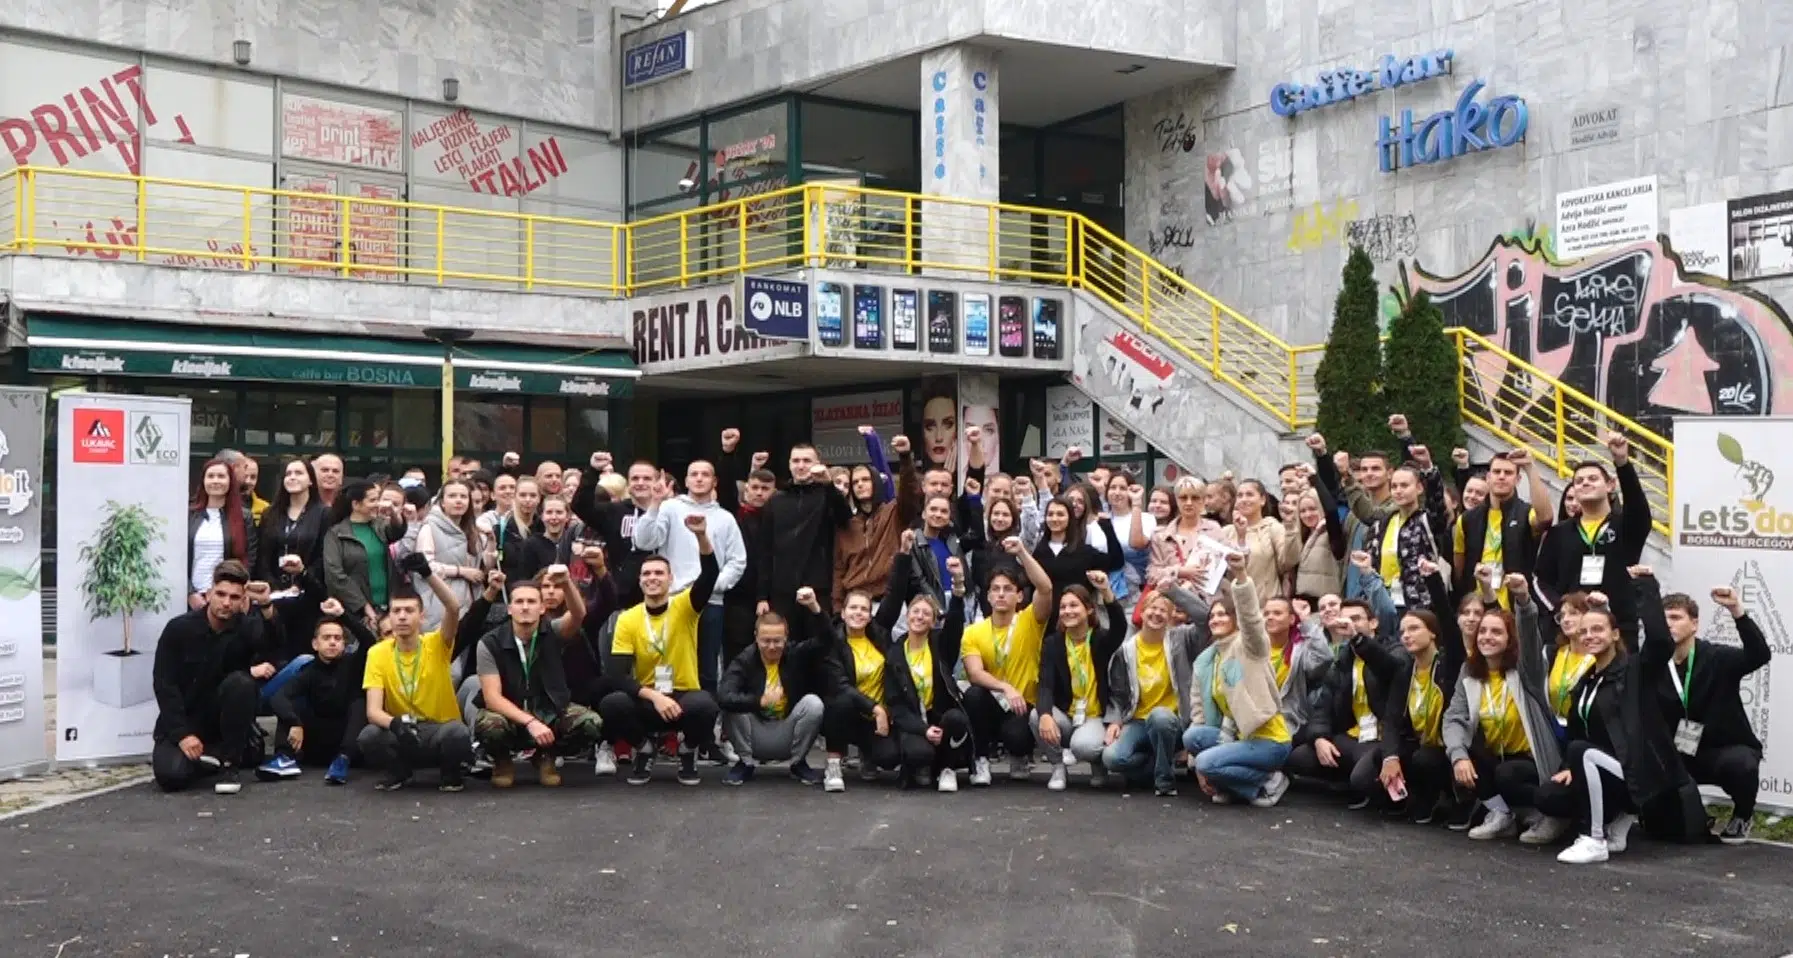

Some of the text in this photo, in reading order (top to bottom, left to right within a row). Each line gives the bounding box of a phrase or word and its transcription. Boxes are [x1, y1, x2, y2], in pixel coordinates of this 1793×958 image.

[1271, 48, 1454, 117] Caffe bar
[0, 64, 157, 173] PRINT
[410, 107, 473, 150] NALJEPNICE
[1377, 77, 1529, 173] Hako
[1571, 108, 1617, 128] ADVOKAT
[320, 125, 360, 146] print
[439, 122, 481, 151] VIZITKE
[469, 124, 512, 155] FLAJERI
[458, 149, 502, 180] PLAKATI
[1561, 183, 1653, 208] ADVOKATSKA KANCELARIJA
[751, 281, 802, 294] BANKOMAT
[774, 300, 803, 318] NLB
[633, 302, 689, 365] RENT
[694, 300, 711, 357] A
[346, 365, 415, 385] BOSNA
[156, 449, 178, 460] ECO
[1686, 535, 1725, 546] BOSNA
